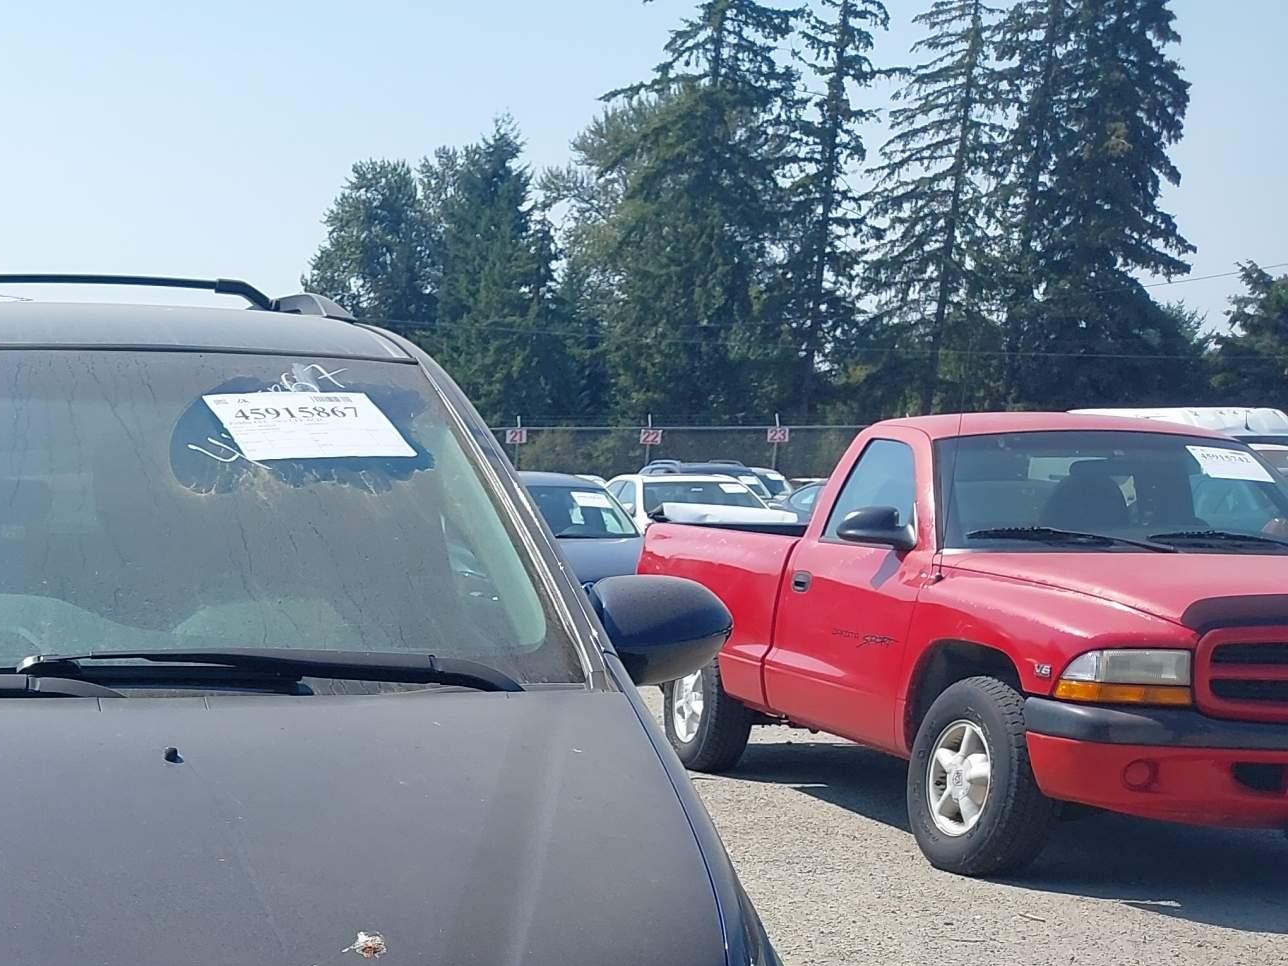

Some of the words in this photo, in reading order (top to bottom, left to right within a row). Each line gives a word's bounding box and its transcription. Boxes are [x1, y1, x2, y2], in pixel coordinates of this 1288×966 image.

[234, 406, 358, 421] 45915867
[509, 430, 524, 442] 21
[641, 431, 659, 443] 22
[769, 429, 787, 441] 23
[1034, 663, 1051, 675] V6
